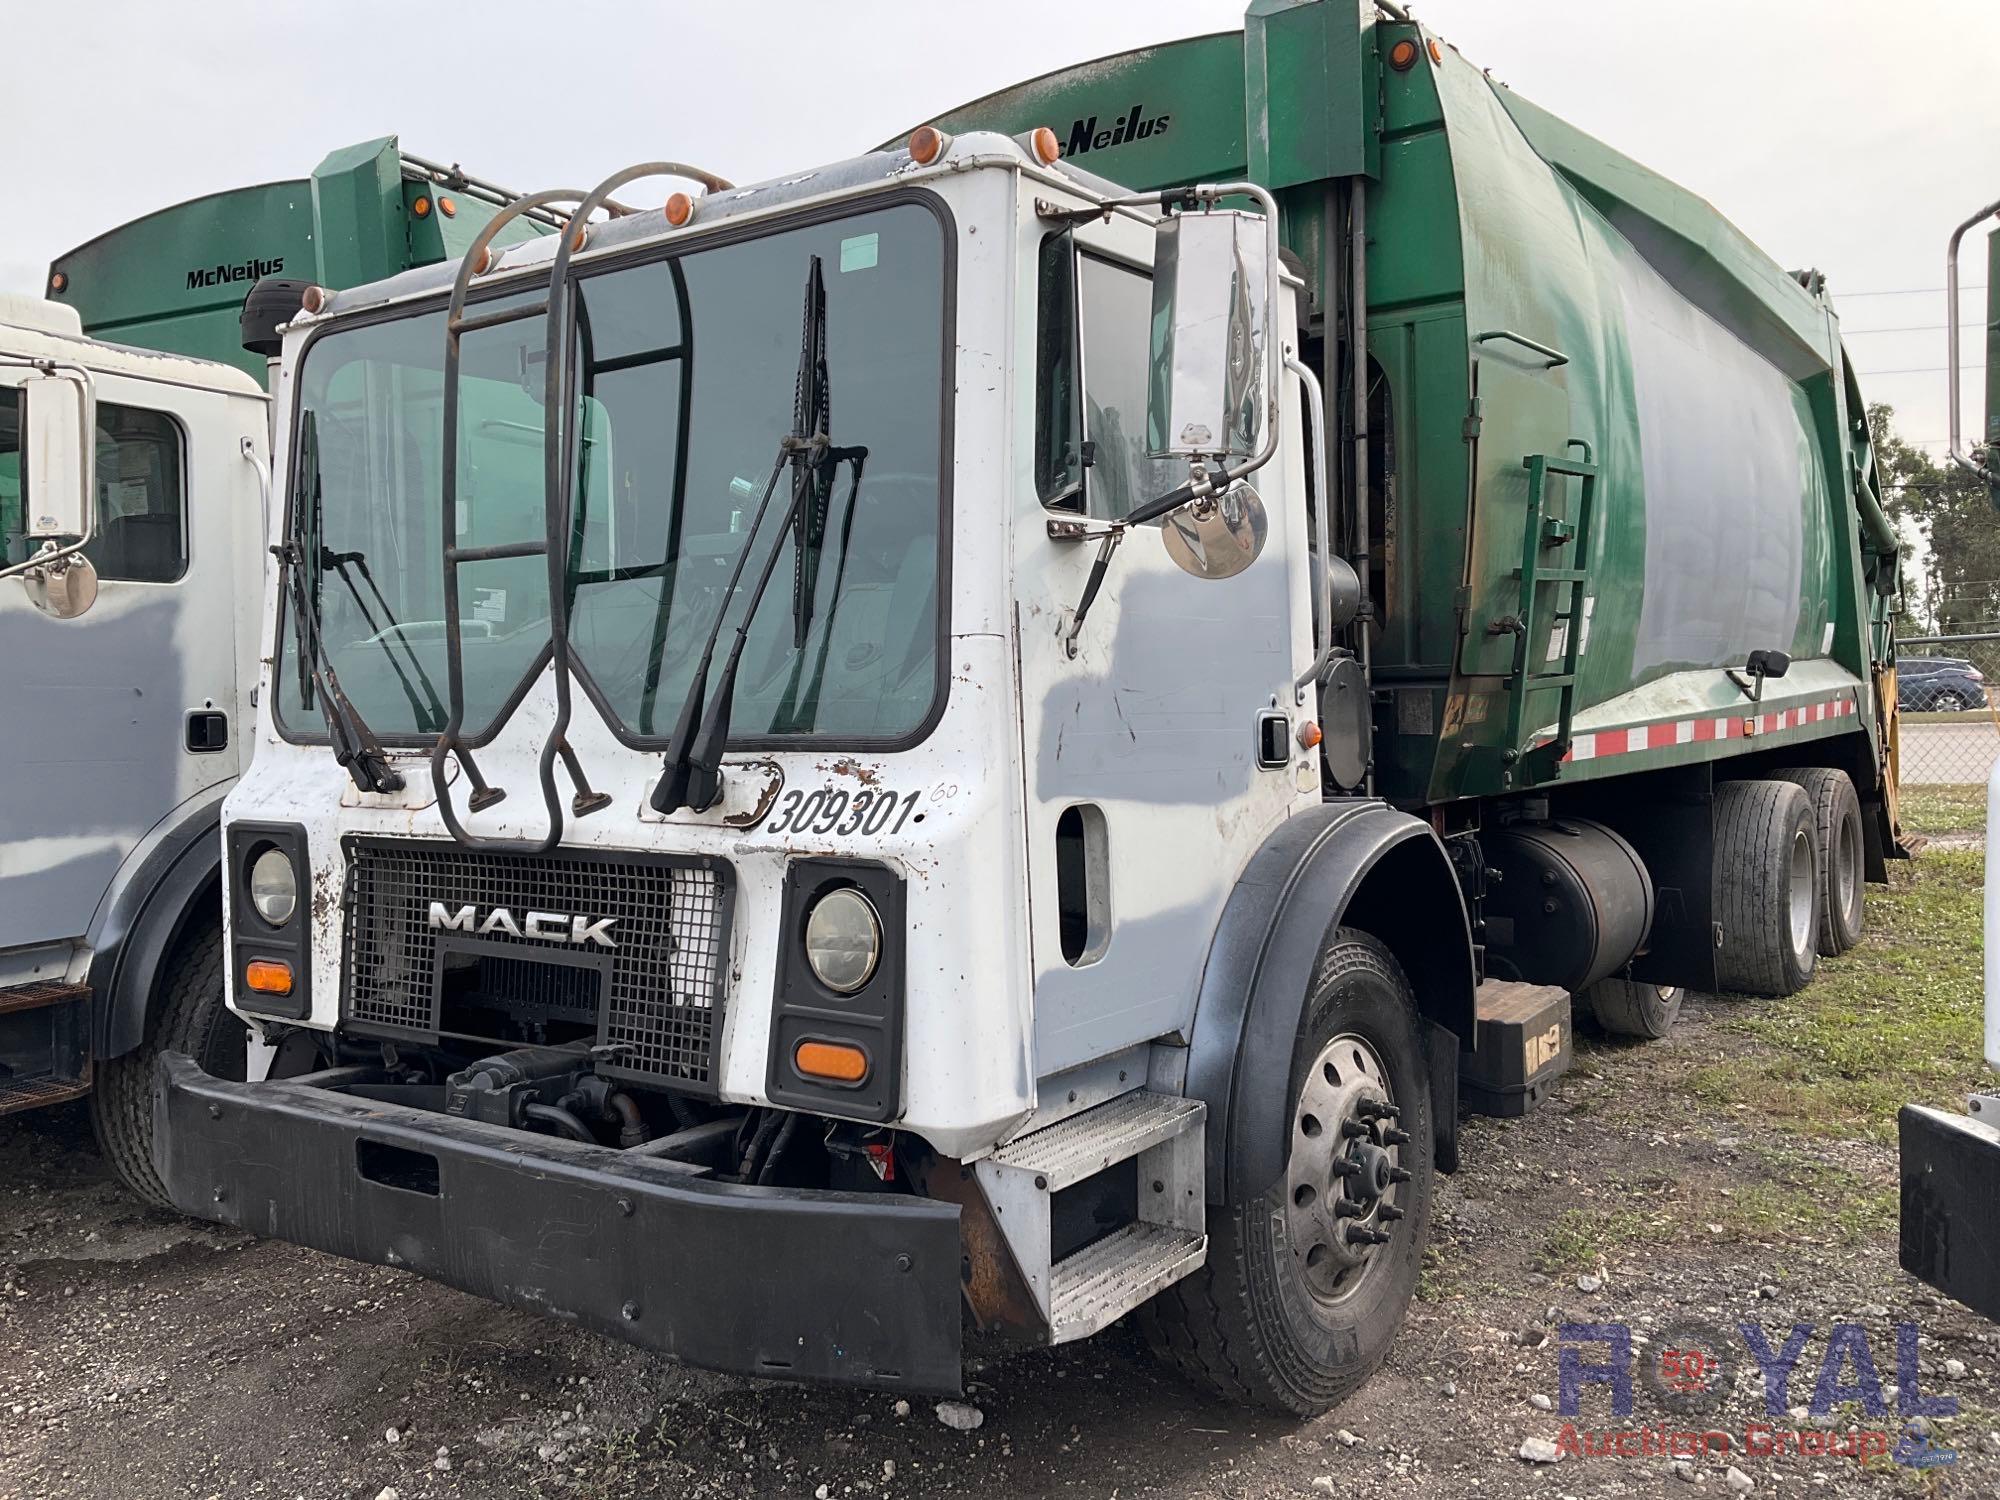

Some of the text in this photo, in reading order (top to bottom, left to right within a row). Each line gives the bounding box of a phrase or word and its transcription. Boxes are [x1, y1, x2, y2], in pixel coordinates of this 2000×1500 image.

[1057, 105, 1170, 158] cNeilus
[186, 258, 284, 290] McNeilus
[768, 790, 922, 836] 309301
[930, 783, 958, 802] 60
[430, 901, 619, 948] MACK
